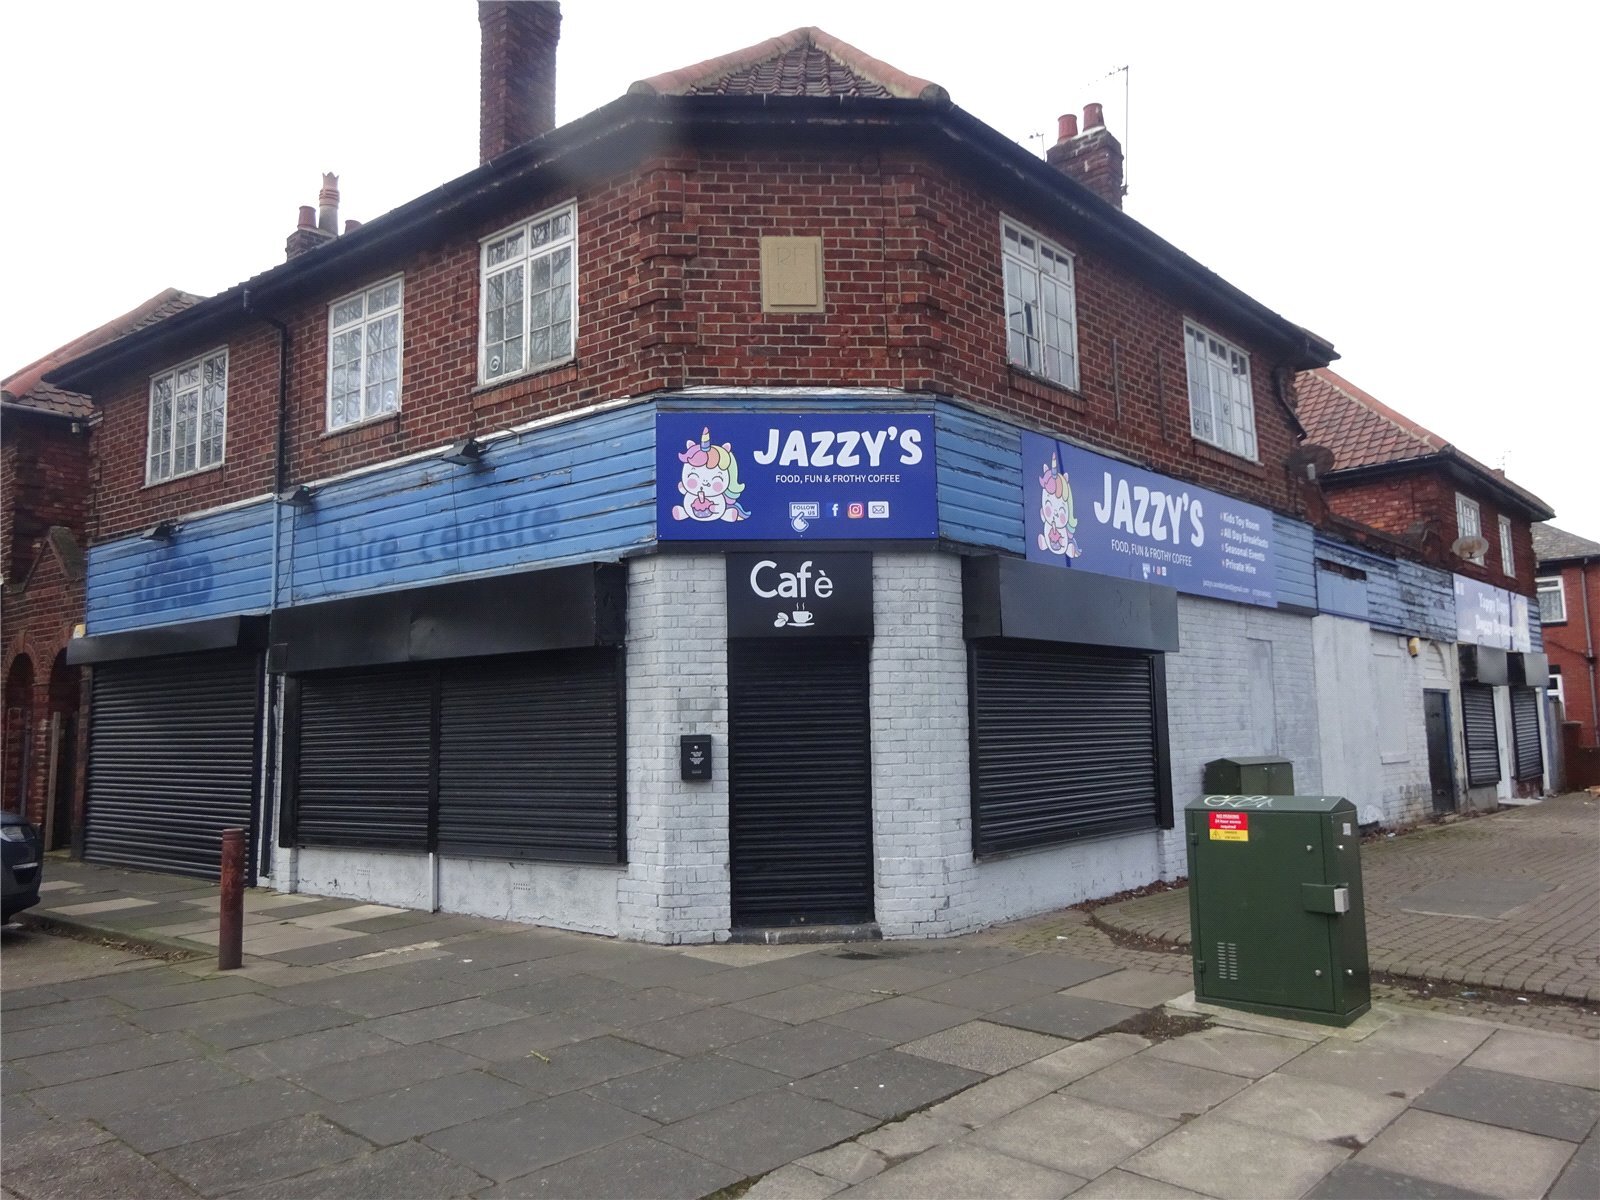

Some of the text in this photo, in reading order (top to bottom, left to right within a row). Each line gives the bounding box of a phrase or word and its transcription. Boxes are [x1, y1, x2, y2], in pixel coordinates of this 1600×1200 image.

[753, 426, 923, 468] JAZZY'S
[775, 474, 901, 484] FOOD, FUN & FROTHY COFFEE
[1094, 471, 1204, 548] JAZZY'S
[1223, 512, 1260, 531] Kids Toy Room
[1111, 539, 1192, 567] FOOD, FUN & FROTHY COFFEE
[1226, 558, 1245, 572] Private
[750, 560, 833, 599] Cafè
